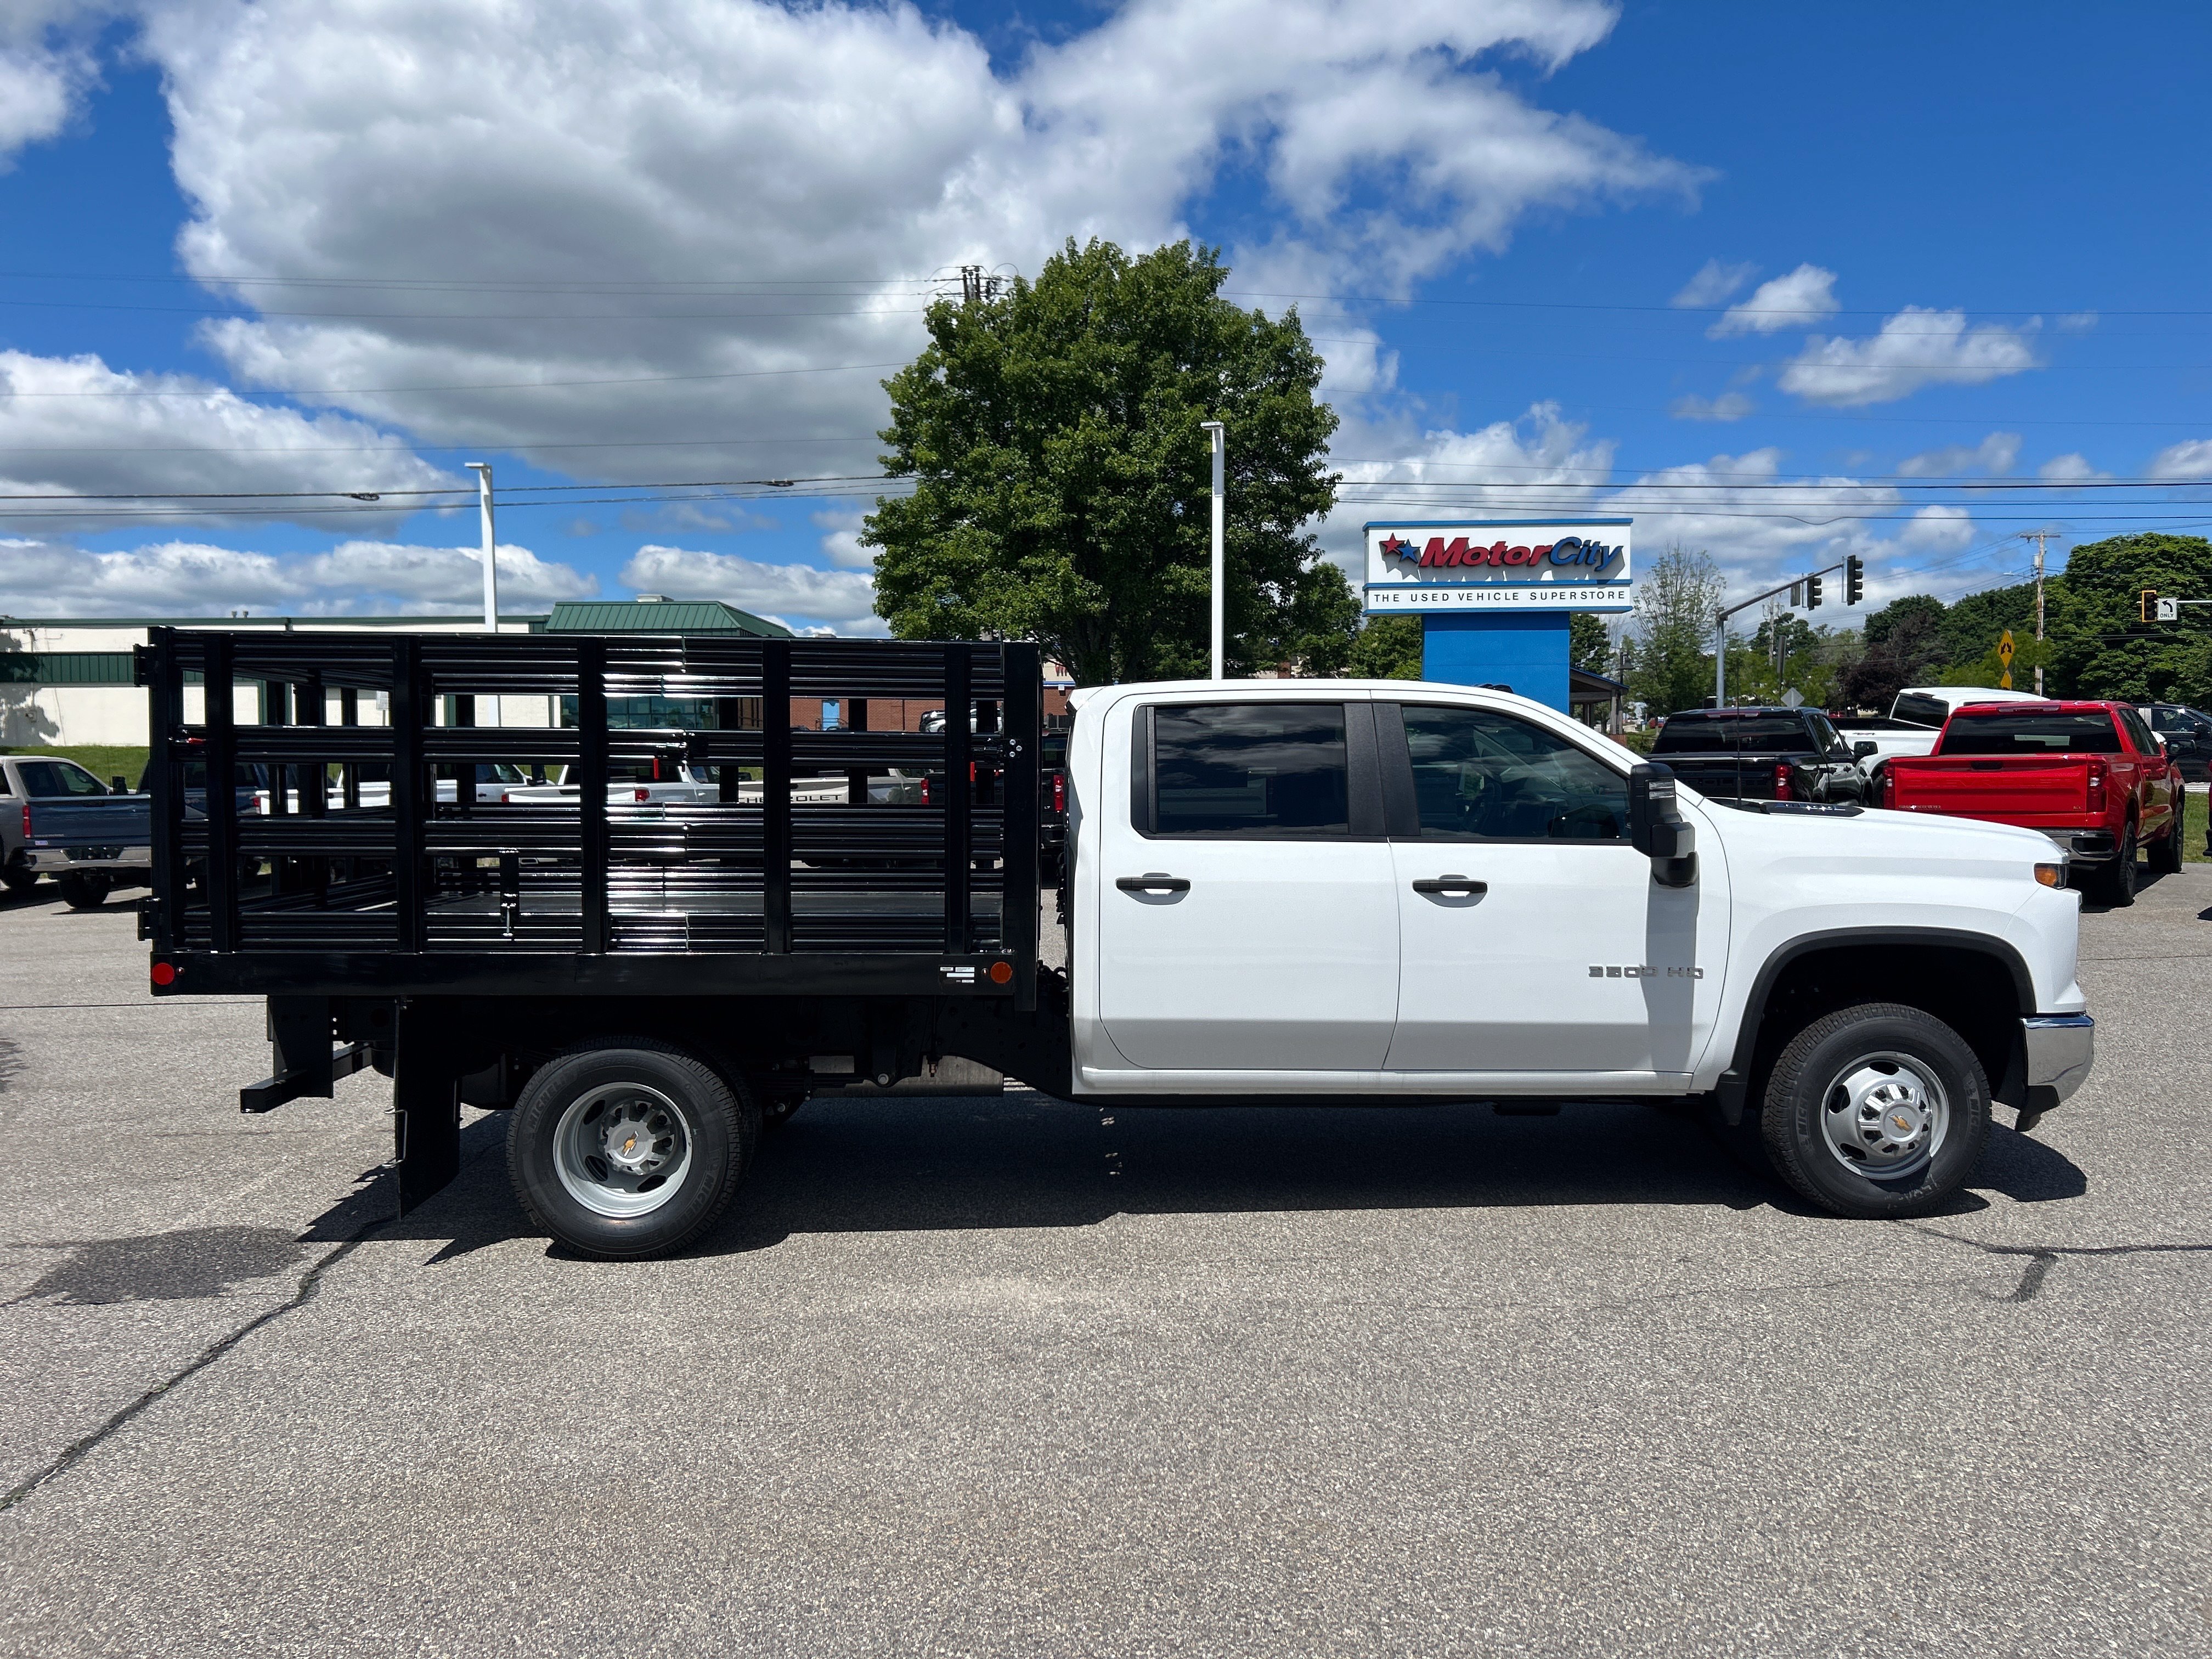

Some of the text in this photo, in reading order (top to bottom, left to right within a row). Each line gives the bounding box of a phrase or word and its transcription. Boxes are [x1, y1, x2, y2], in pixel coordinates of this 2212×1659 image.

[1418, 536, 1624, 572] MotorCity
[1374, 591, 1625, 602] THE USED VEHICLE SUPERSTORE
[1588, 966, 1704, 979] 3500 HD
